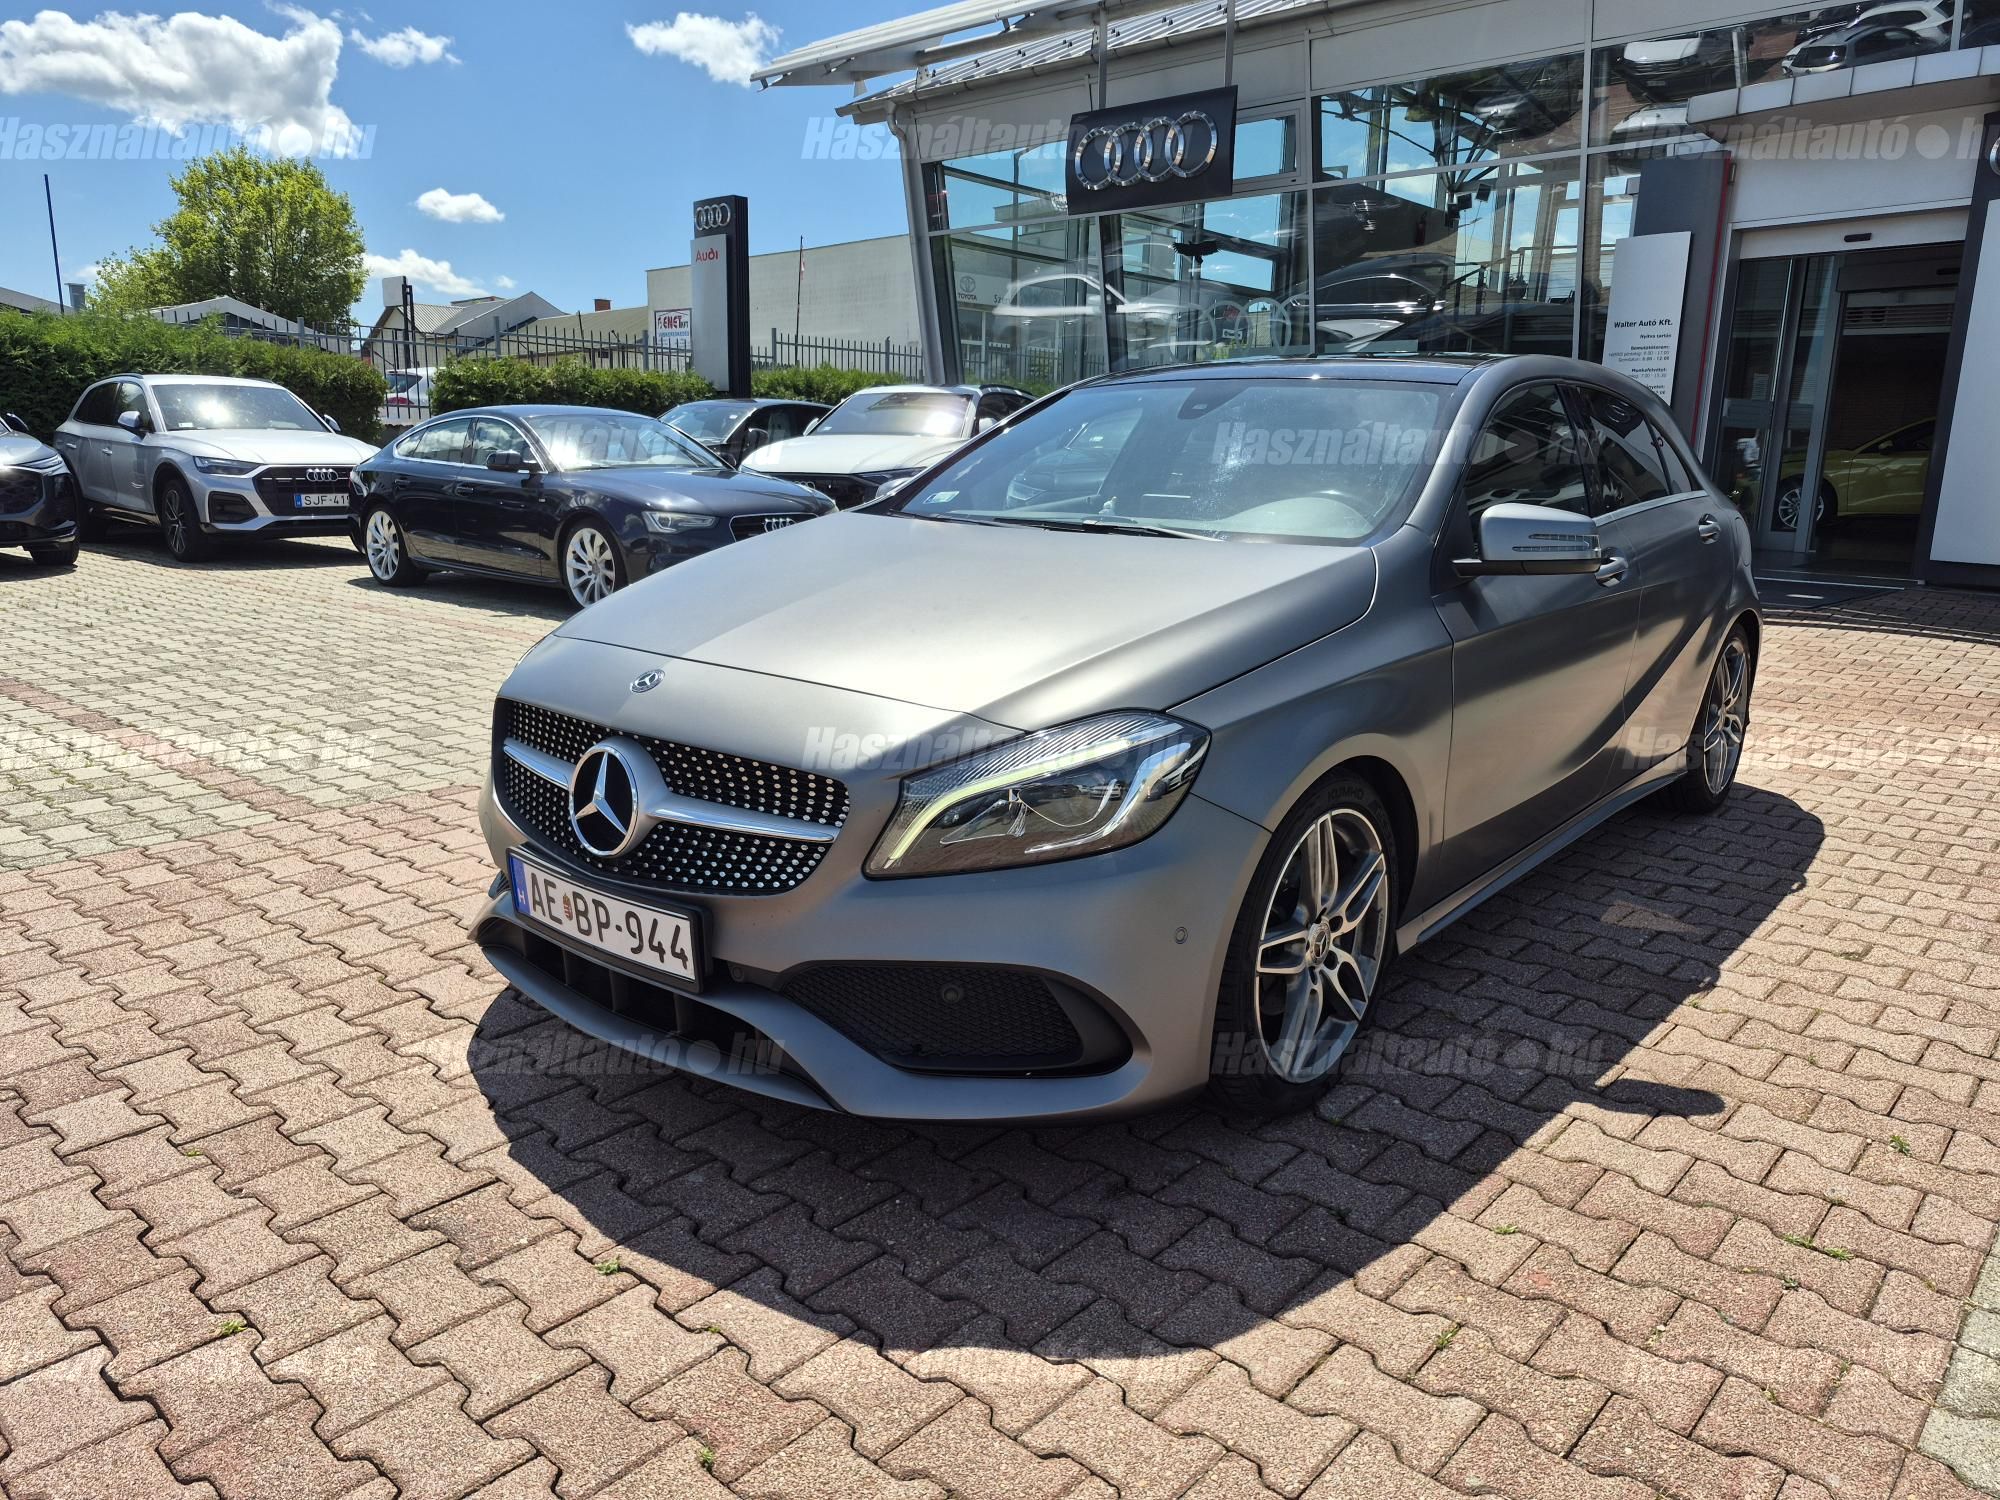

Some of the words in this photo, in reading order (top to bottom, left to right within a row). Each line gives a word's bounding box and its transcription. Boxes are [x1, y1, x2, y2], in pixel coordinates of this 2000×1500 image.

[695, 247, 719, 262] Audi
[958, 292, 977, 301] TOYOTA
[1614, 320, 1637, 328] Walter
[1639, 319, 1657, 327] Autó
[1659, 318, 1673, 326] Kft.
[304, 495, 349, 506] SJF-41
